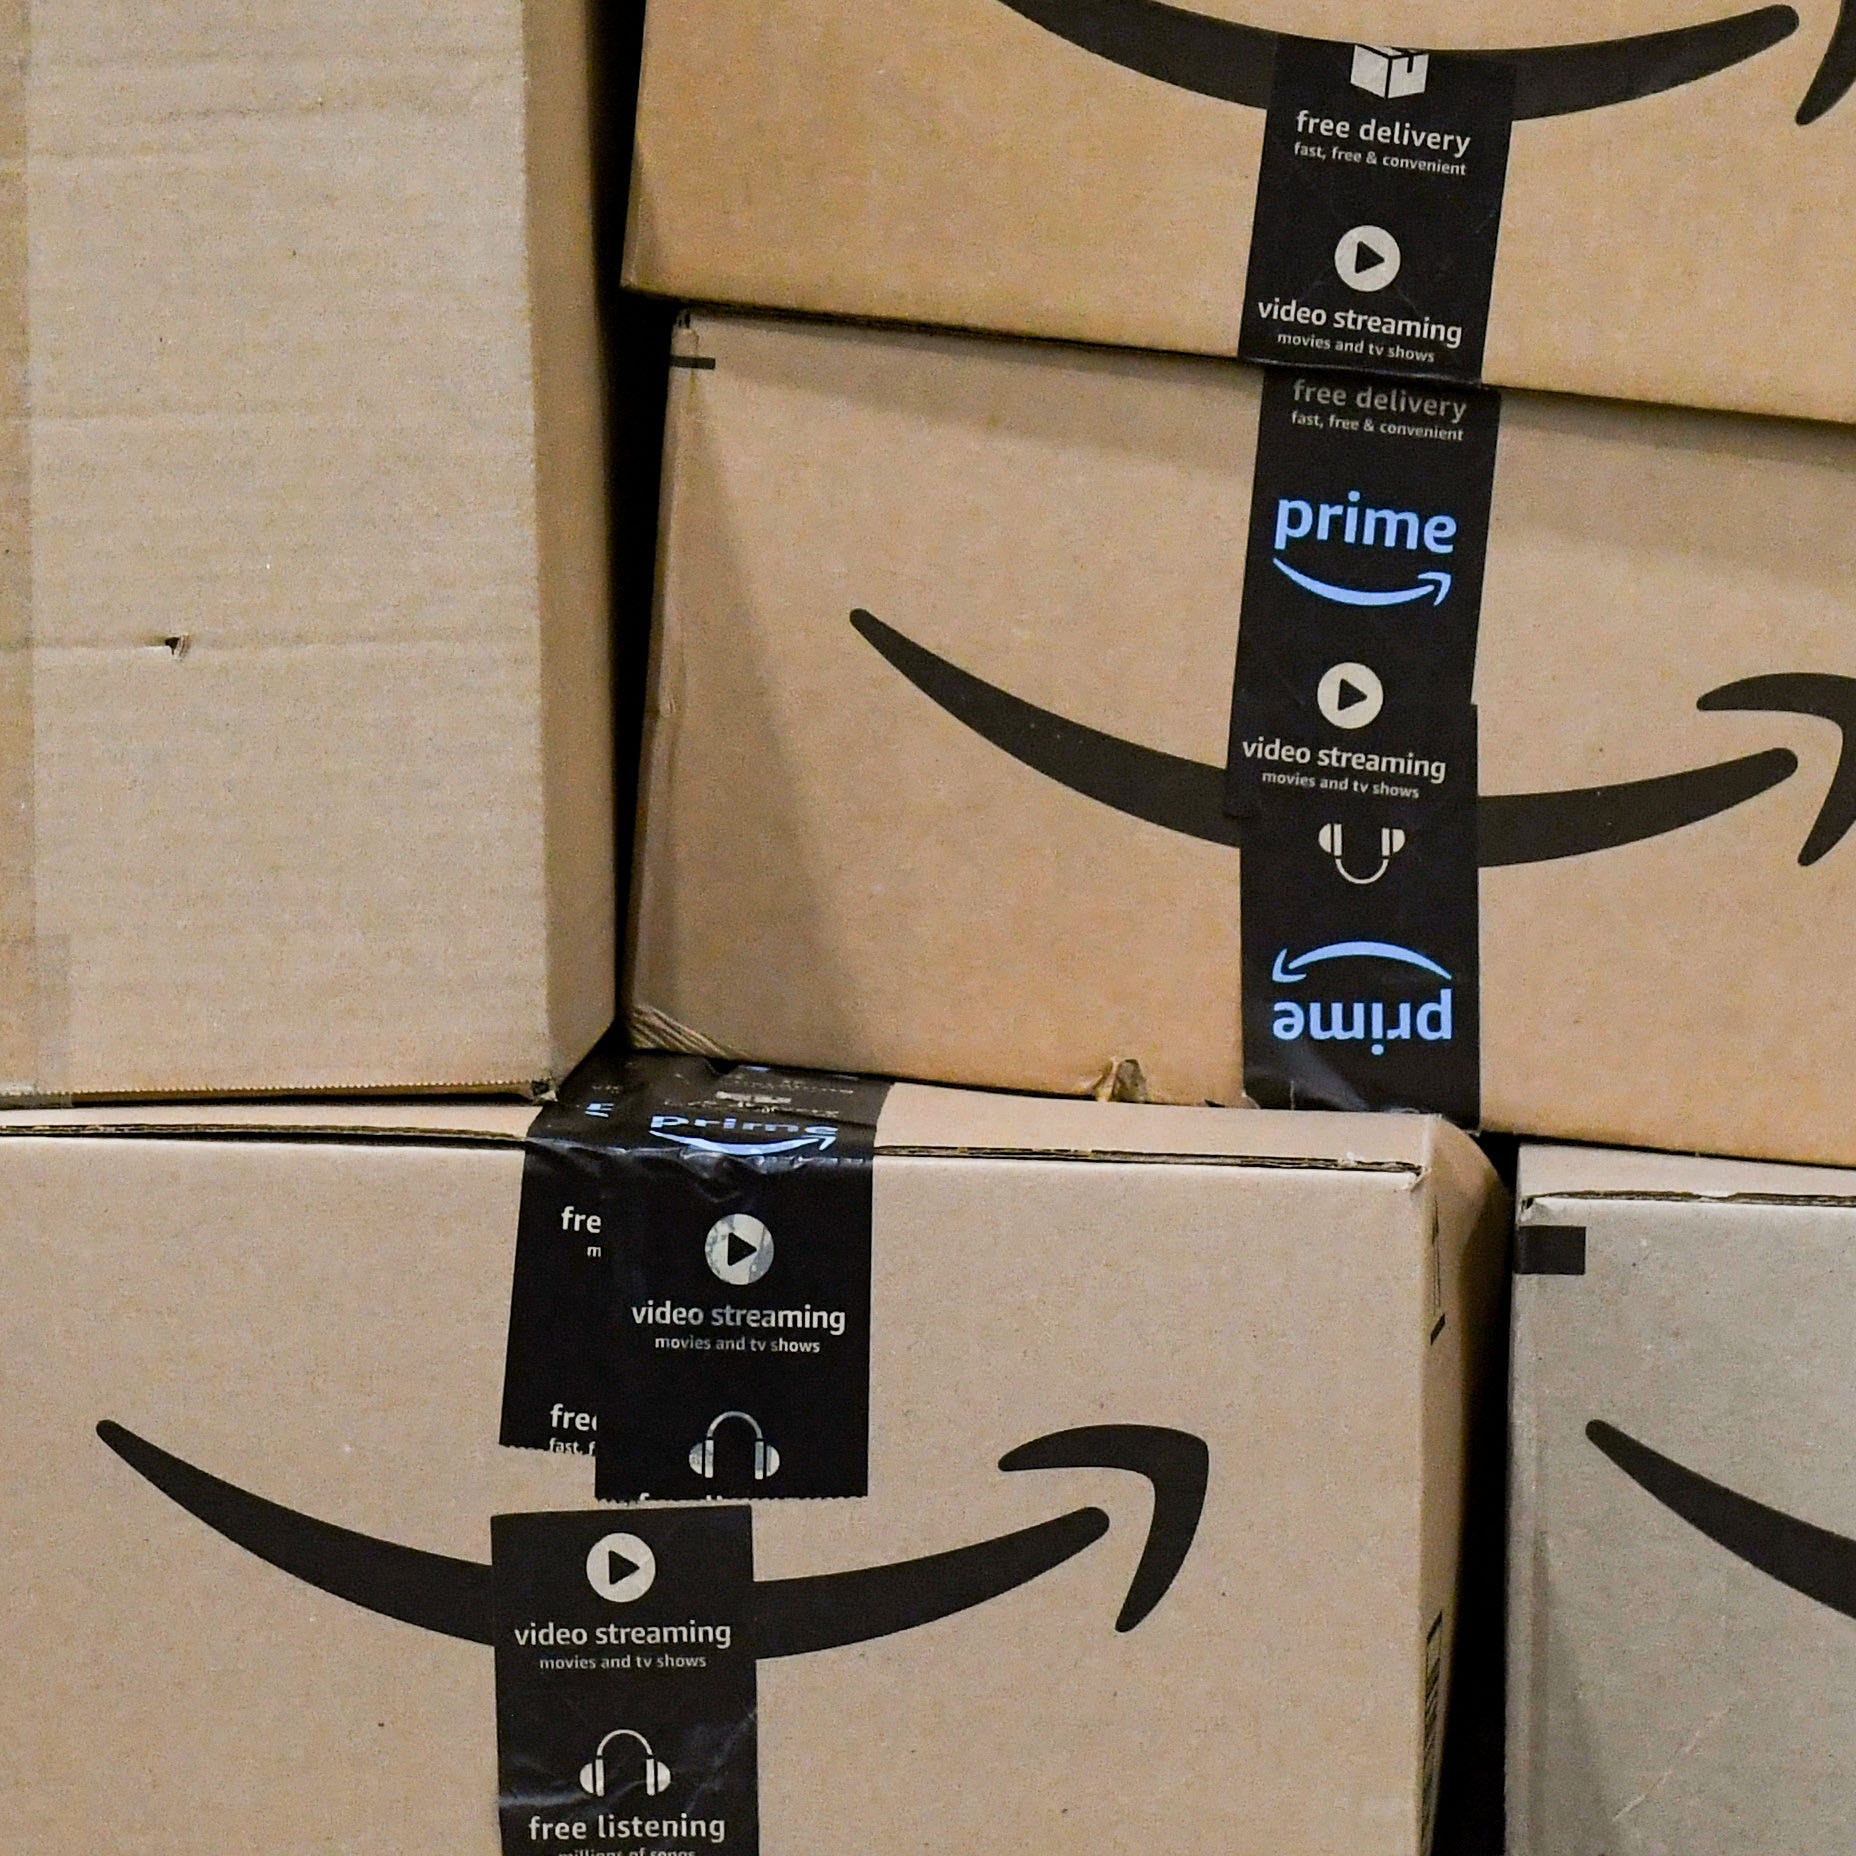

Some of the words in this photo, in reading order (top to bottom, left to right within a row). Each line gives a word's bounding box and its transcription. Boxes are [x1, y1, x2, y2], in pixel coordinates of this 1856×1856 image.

[1296, 110, 1351, 139] free
[1359, 118, 1472, 158] delivery
[1293, 141, 1326, 161] fast,
[1331, 146, 1362, 163] free
[1365, 151, 1378, 165] &
[1382, 154, 1466, 176] convenient
[1257, 297, 1327, 325] video
[1333, 307, 1463, 349] streaming
[1277, 331, 1331, 351] movies
[1335, 338, 1364, 354] and
[1368, 342, 1384, 355] tv
[1388, 344, 1435, 363] shows
[1293, 378, 1348, 407] free
[1355, 387, 1467, 424] delivery
[1291, 410, 1325, 429] fast,
[1328, 414, 1360, 431] free
[1363, 418, 1375, 433] &
[1379, 420, 1464, 442] convenient
[1274, 490, 1458, 554] prime
[1242, 736, 1312, 765] video
[1317, 747, 1447, 785] streaming
[1272, 988, 1453, 1057] prime
[630, 1300, 705, 1326] video
[711, 1304, 847, 1336] streaming
[514, 1622, 588, 1646] video
[595, 1620, 732, 1650] streaming
[539, 1656, 596, 1670] movies
[600, 1655, 630, 1669] and
[635, 1656, 652, 1668] tv
[656, 1654, 707, 1668] shows
[528, 1816, 587, 1841] free
[598, 1812, 726, 1842] listening
